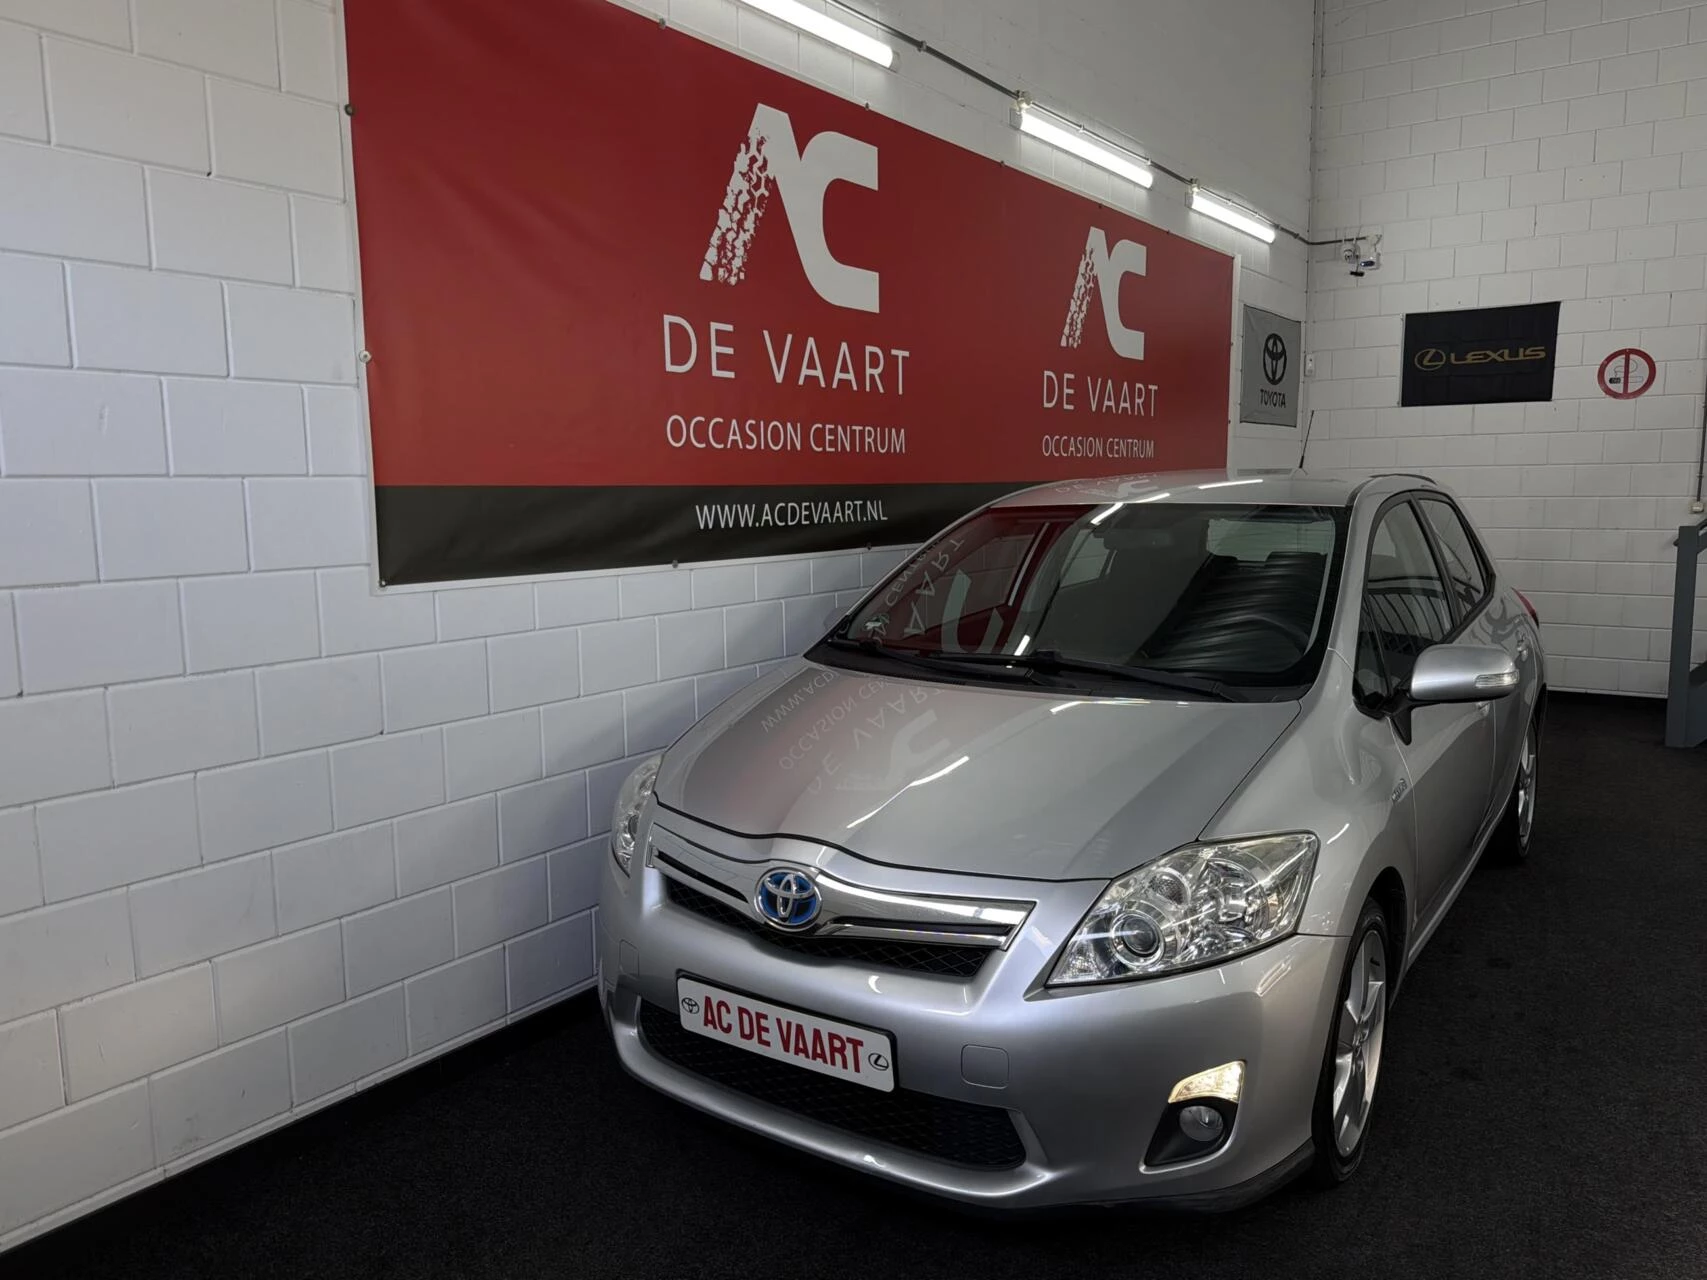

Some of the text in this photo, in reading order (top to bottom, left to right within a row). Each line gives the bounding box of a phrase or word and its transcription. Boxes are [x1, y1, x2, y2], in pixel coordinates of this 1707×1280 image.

[699, 103, 879, 313] AC
[1060, 226, 1147, 360] AC
[663, 314, 910, 395] DE VAART
[1450, 346, 1545, 365] LEXUS
[1043, 370, 1158, 417] DE VAART
[1260, 389, 1286, 408] TOYOTA
[666, 415, 905, 453] OCCASION CENTRUM
[1042, 435, 1154, 459] OCCASION CENTRUM
[695, 500, 888, 530] WWW.ACDEVAART.NL
[703, 996, 732, 1034] AC
[737, 1006, 771, 1047] DE
[776, 1017, 864, 1073] VAART
